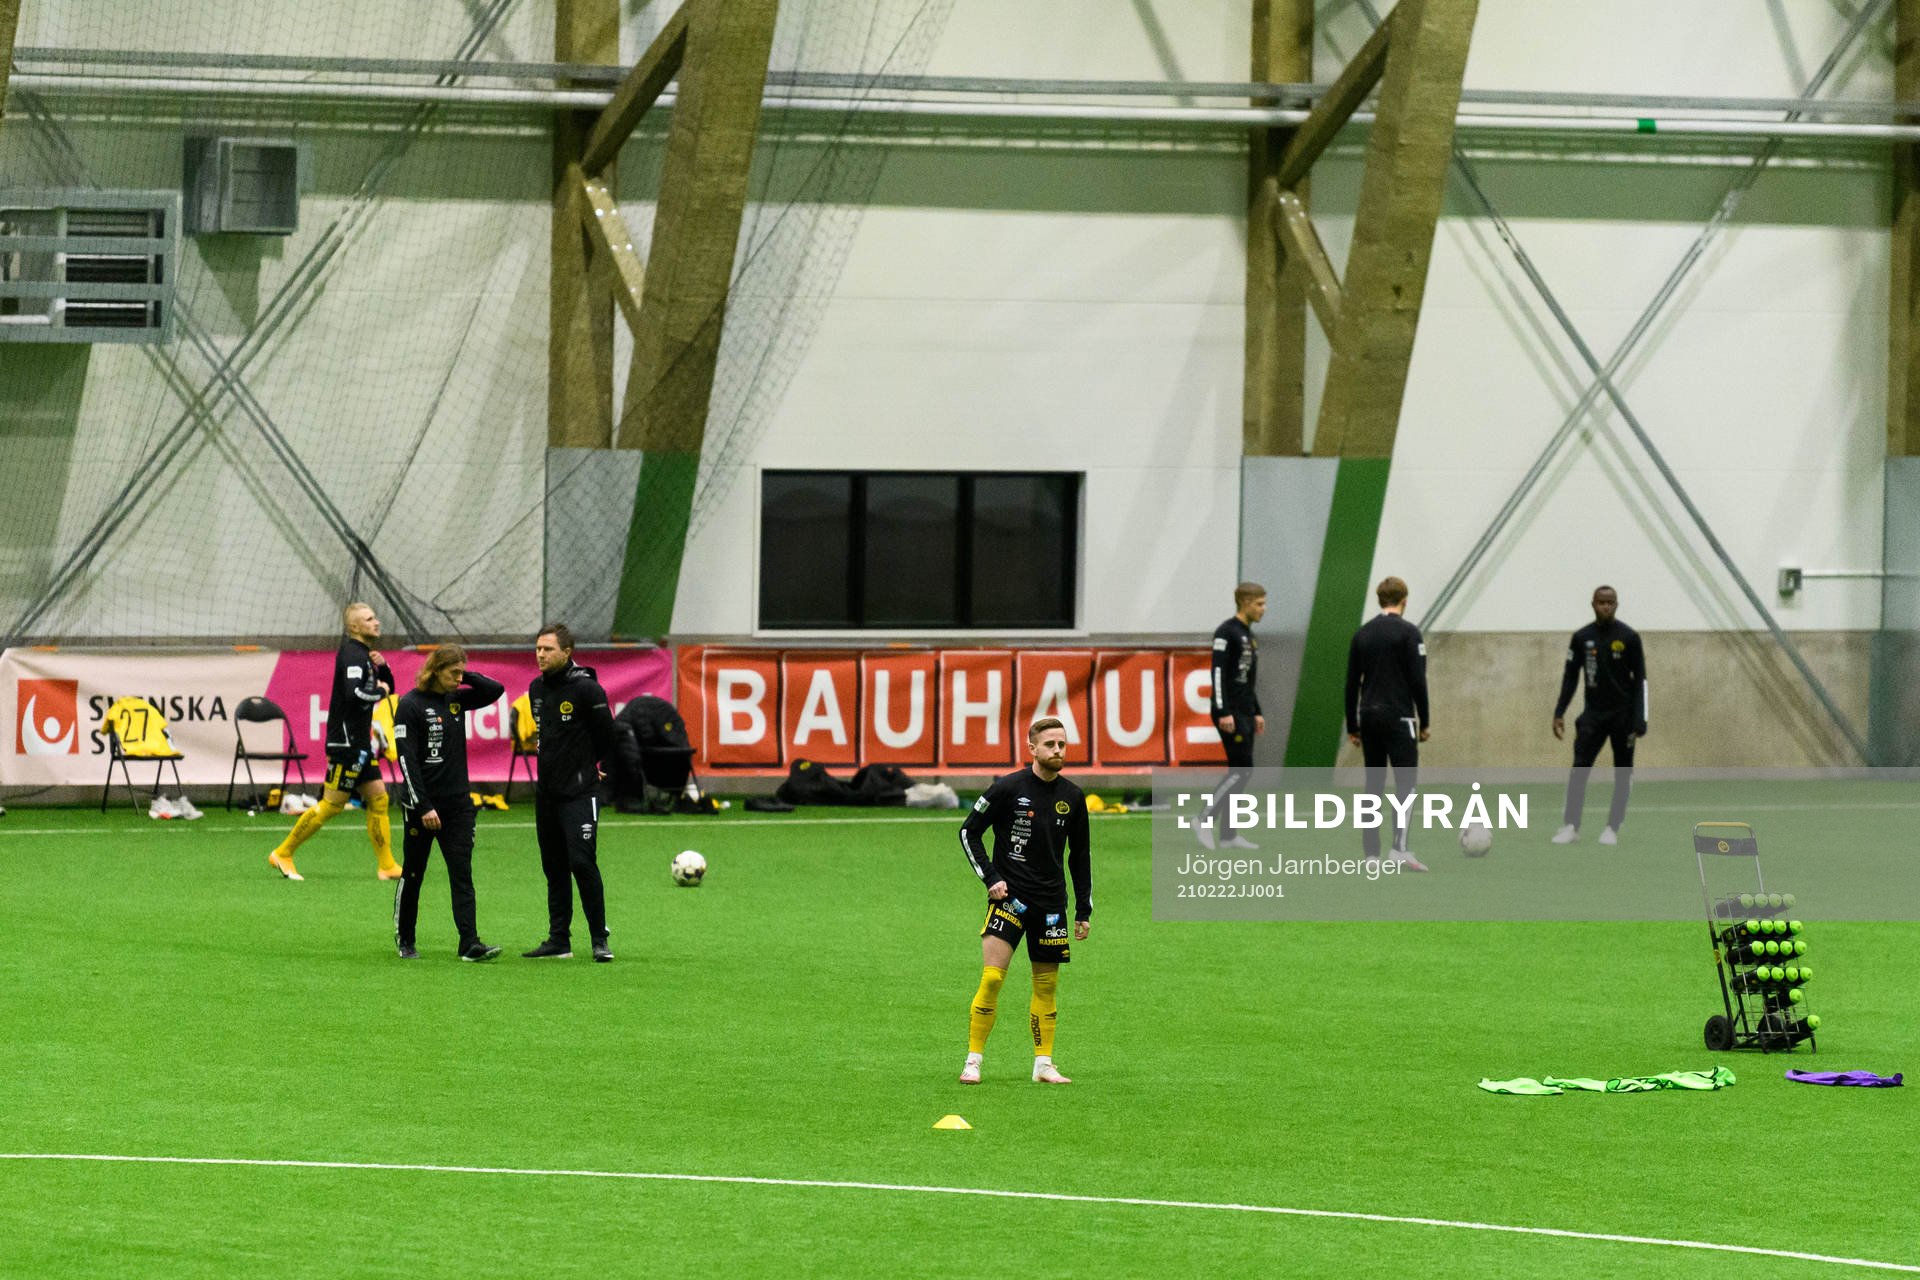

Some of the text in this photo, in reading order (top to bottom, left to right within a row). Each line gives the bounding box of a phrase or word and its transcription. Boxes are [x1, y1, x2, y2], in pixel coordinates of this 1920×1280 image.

[89, 695, 227, 722] SNSKA
[717, 669, 1223, 747] BAUHAUS
[120, 708, 149, 743] 27
[992, 918, 1005, 932] 21
